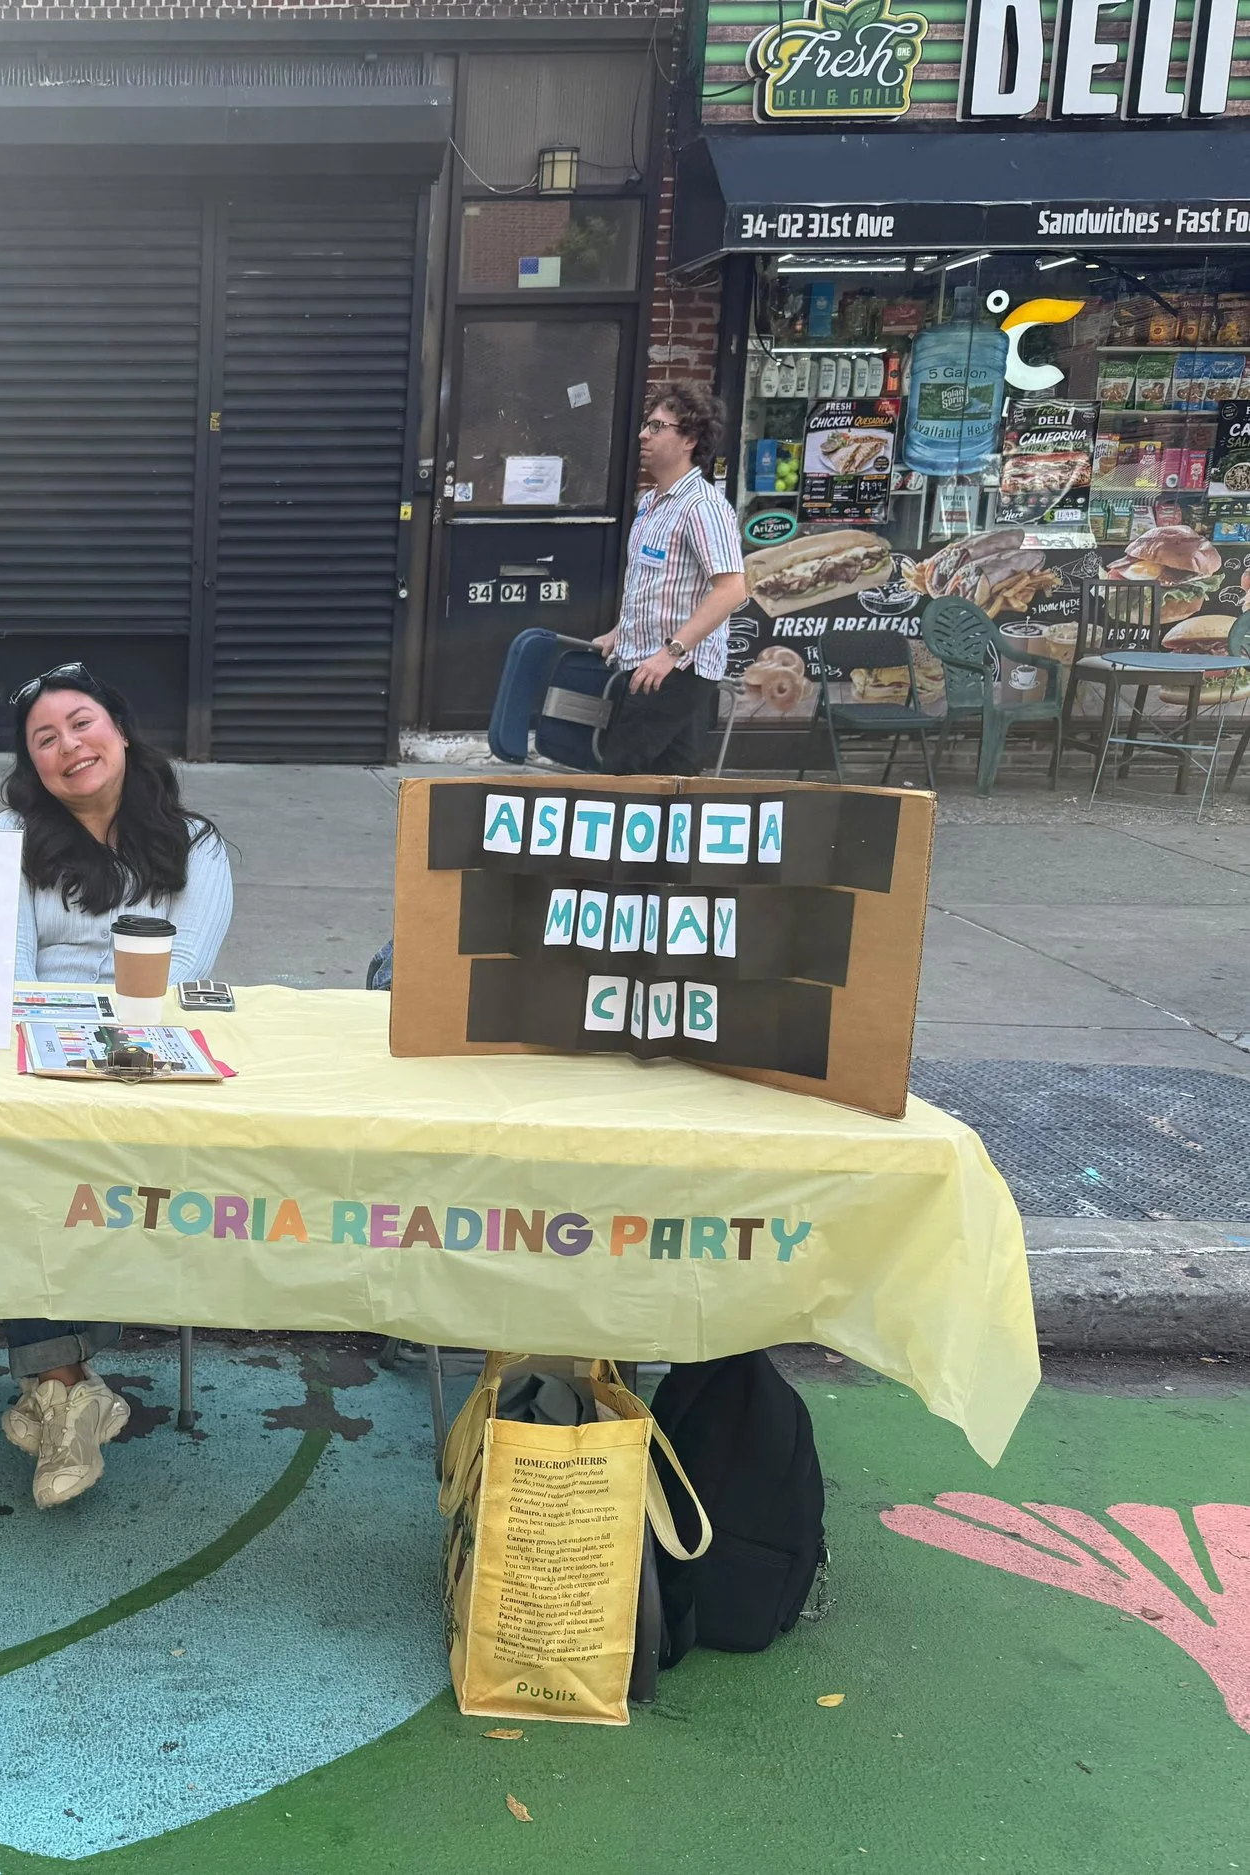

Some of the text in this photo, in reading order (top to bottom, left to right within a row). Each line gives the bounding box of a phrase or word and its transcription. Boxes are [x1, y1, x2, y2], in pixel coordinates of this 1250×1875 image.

[767, 23, 918, 86] Fresh
[971, 0, 1238, 115] DELI
[775, 88, 905, 106] DELI & GRILL
[741, 212, 894, 238] 34-02 31st Ave
[1037, 206, 1250, 234] Sandwiches Fast Fo
[928, 368, 987, 380] 5 Galon
[826, 402, 852, 411] FRESH
[810, 416, 892, 428] CHICKEN QUESADILLA
[912, 420, 962, 438] Available
[1038, 416, 1066, 425] DELI
[1018, 430, 1086, 446] CALIFORNIA
[1227, 437, 1250, 448] SAL
[469, 584, 562, 601] 34 04 31
[772, 616, 923, 636] FRESH BREAKFAS
[484, 802, 781, 854] ASTORIA
[546, 898, 734, 950] MONDAY
[592, 984, 713, 1032] CLUB
[64, 1184, 812, 1262] ASTORIA READING PARTY
[514, 1456, 608, 1470] HOMEGROWN HERBS
[510, 1505, 542, 1517] Cilantro,
[500, 1594, 542, 1608] Lemongrass
[498, 1612, 522, 1623] Parsley
[524, 1617, 536, 1626] can
[536, 1620, 553, 1628] grow
[566, 1616, 588, 1626] without
[497, 1637, 525, 1649] Thyme's
[526, 1644, 543, 1653] small
[557, 1646, 575, 1654] makes
[589, 1642, 602, 1650] ideal
[516, 1682, 576, 1702] Publix
